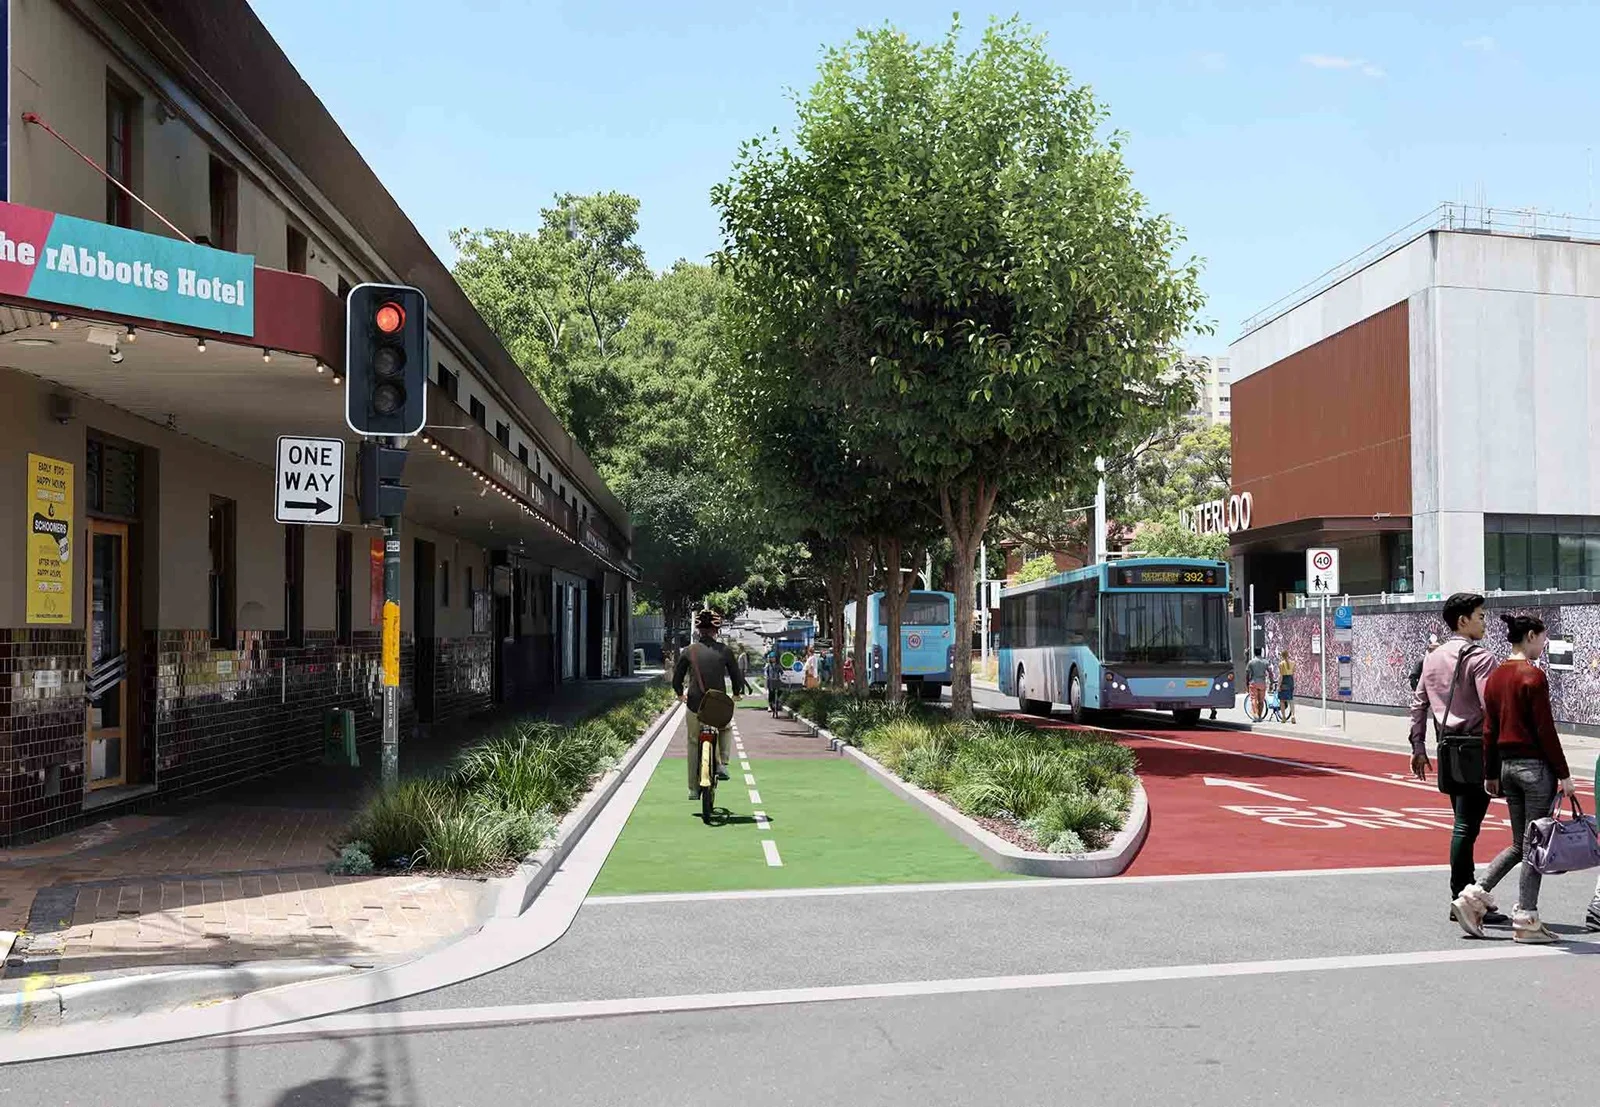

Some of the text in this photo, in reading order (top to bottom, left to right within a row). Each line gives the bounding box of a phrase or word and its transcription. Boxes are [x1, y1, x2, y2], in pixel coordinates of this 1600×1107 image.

[0, 231, 245, 306] he rAbbotts Hotel
[289, 446, 332, 466] ONE
[285, 472, 335, 492] WAY
[34, 520, 67, 534] SCHOONERS
[1316, 556, 1330, 565] 40
[1183, 571, 1204, 582] 392
[911, 637, 919, 645] 40
